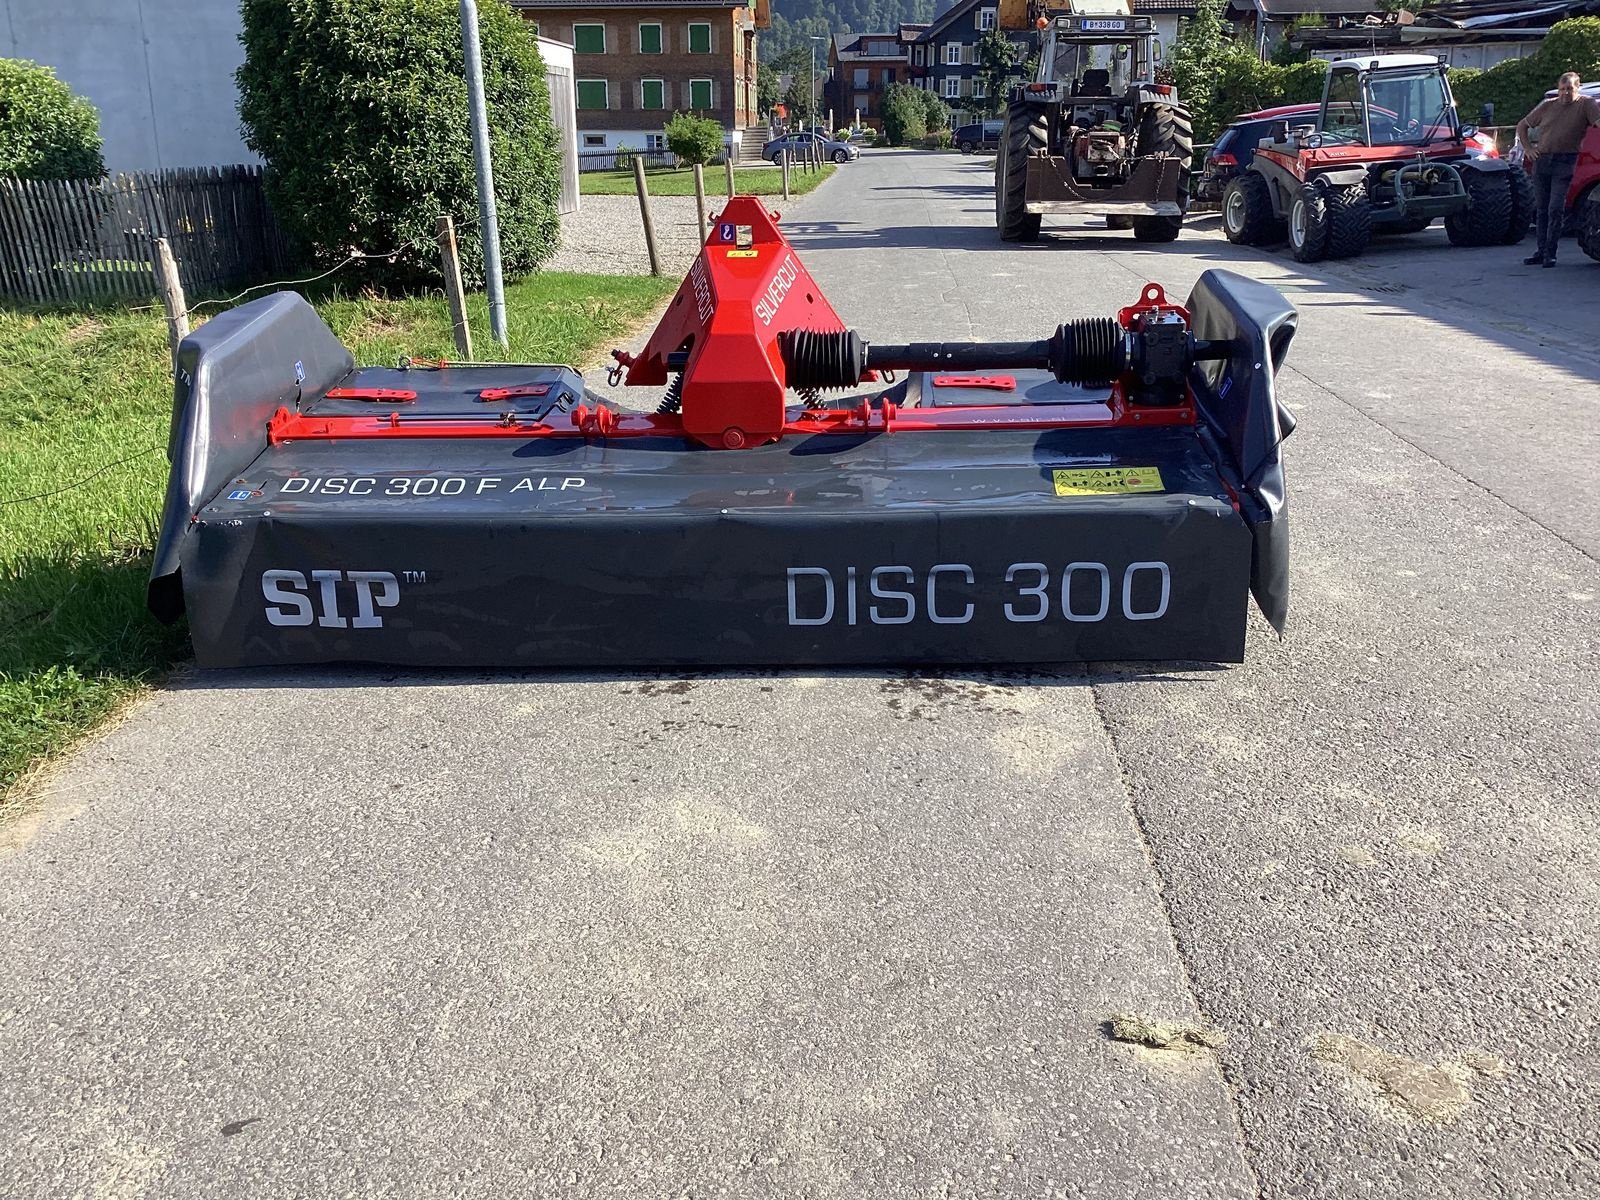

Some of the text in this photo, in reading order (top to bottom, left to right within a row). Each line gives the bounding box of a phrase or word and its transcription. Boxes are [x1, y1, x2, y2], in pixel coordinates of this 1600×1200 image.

[690, 256, 714, 326] SILVERCUT
[755, 254, 798, 326] SILVERCUT
[280, 477, 587, 496] DISC 300 F ALP
[261, 569, 400, 628] SIP
[786, 562, 1171, 625] DISC 300
